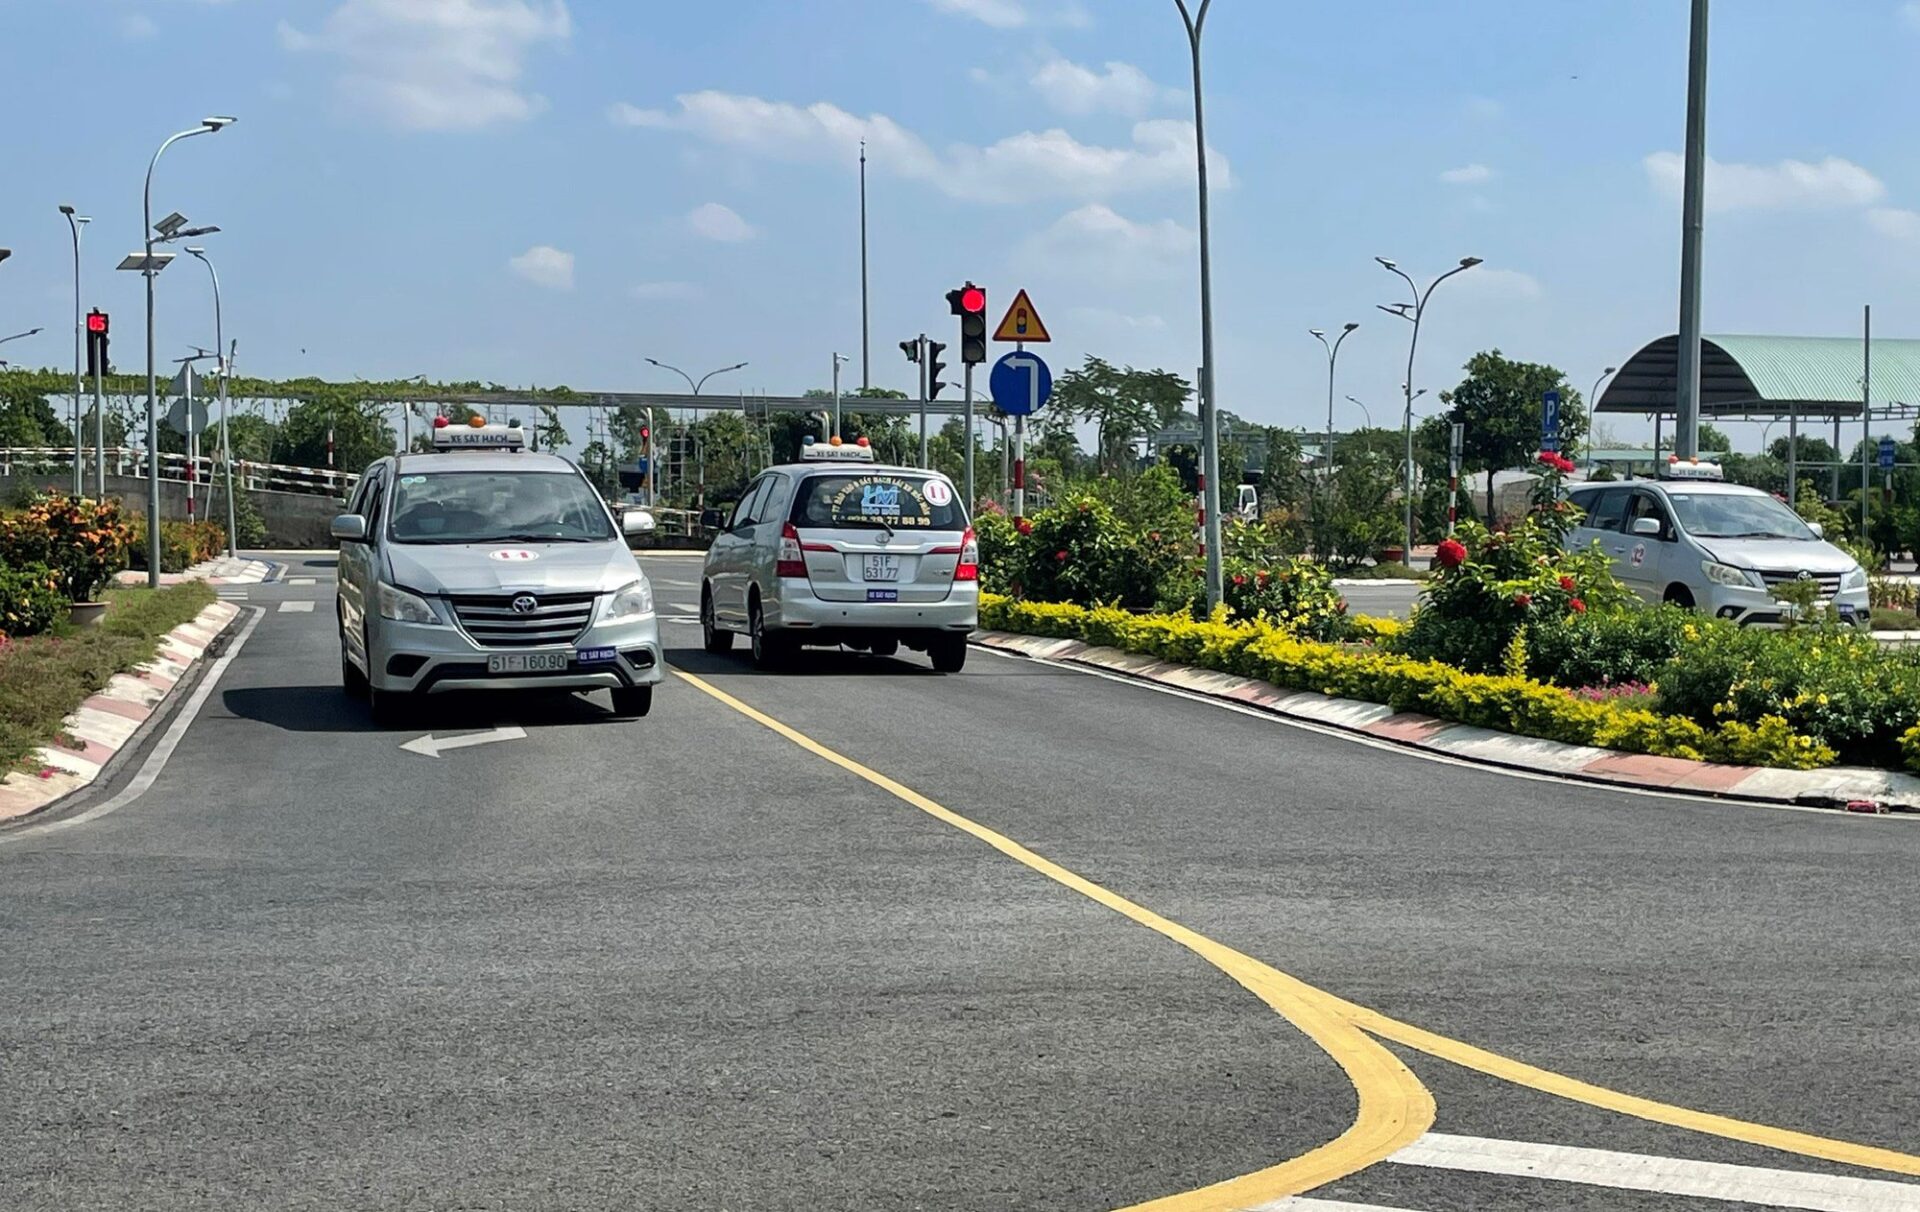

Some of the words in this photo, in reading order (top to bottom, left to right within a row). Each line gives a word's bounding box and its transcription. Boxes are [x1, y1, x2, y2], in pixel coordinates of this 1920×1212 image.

[89, 315, 106, 331] 05
[1546, 400, 1555, 426] P
[886, 516, 898, 525] 77
[872, 555, 892, 567] 51F
